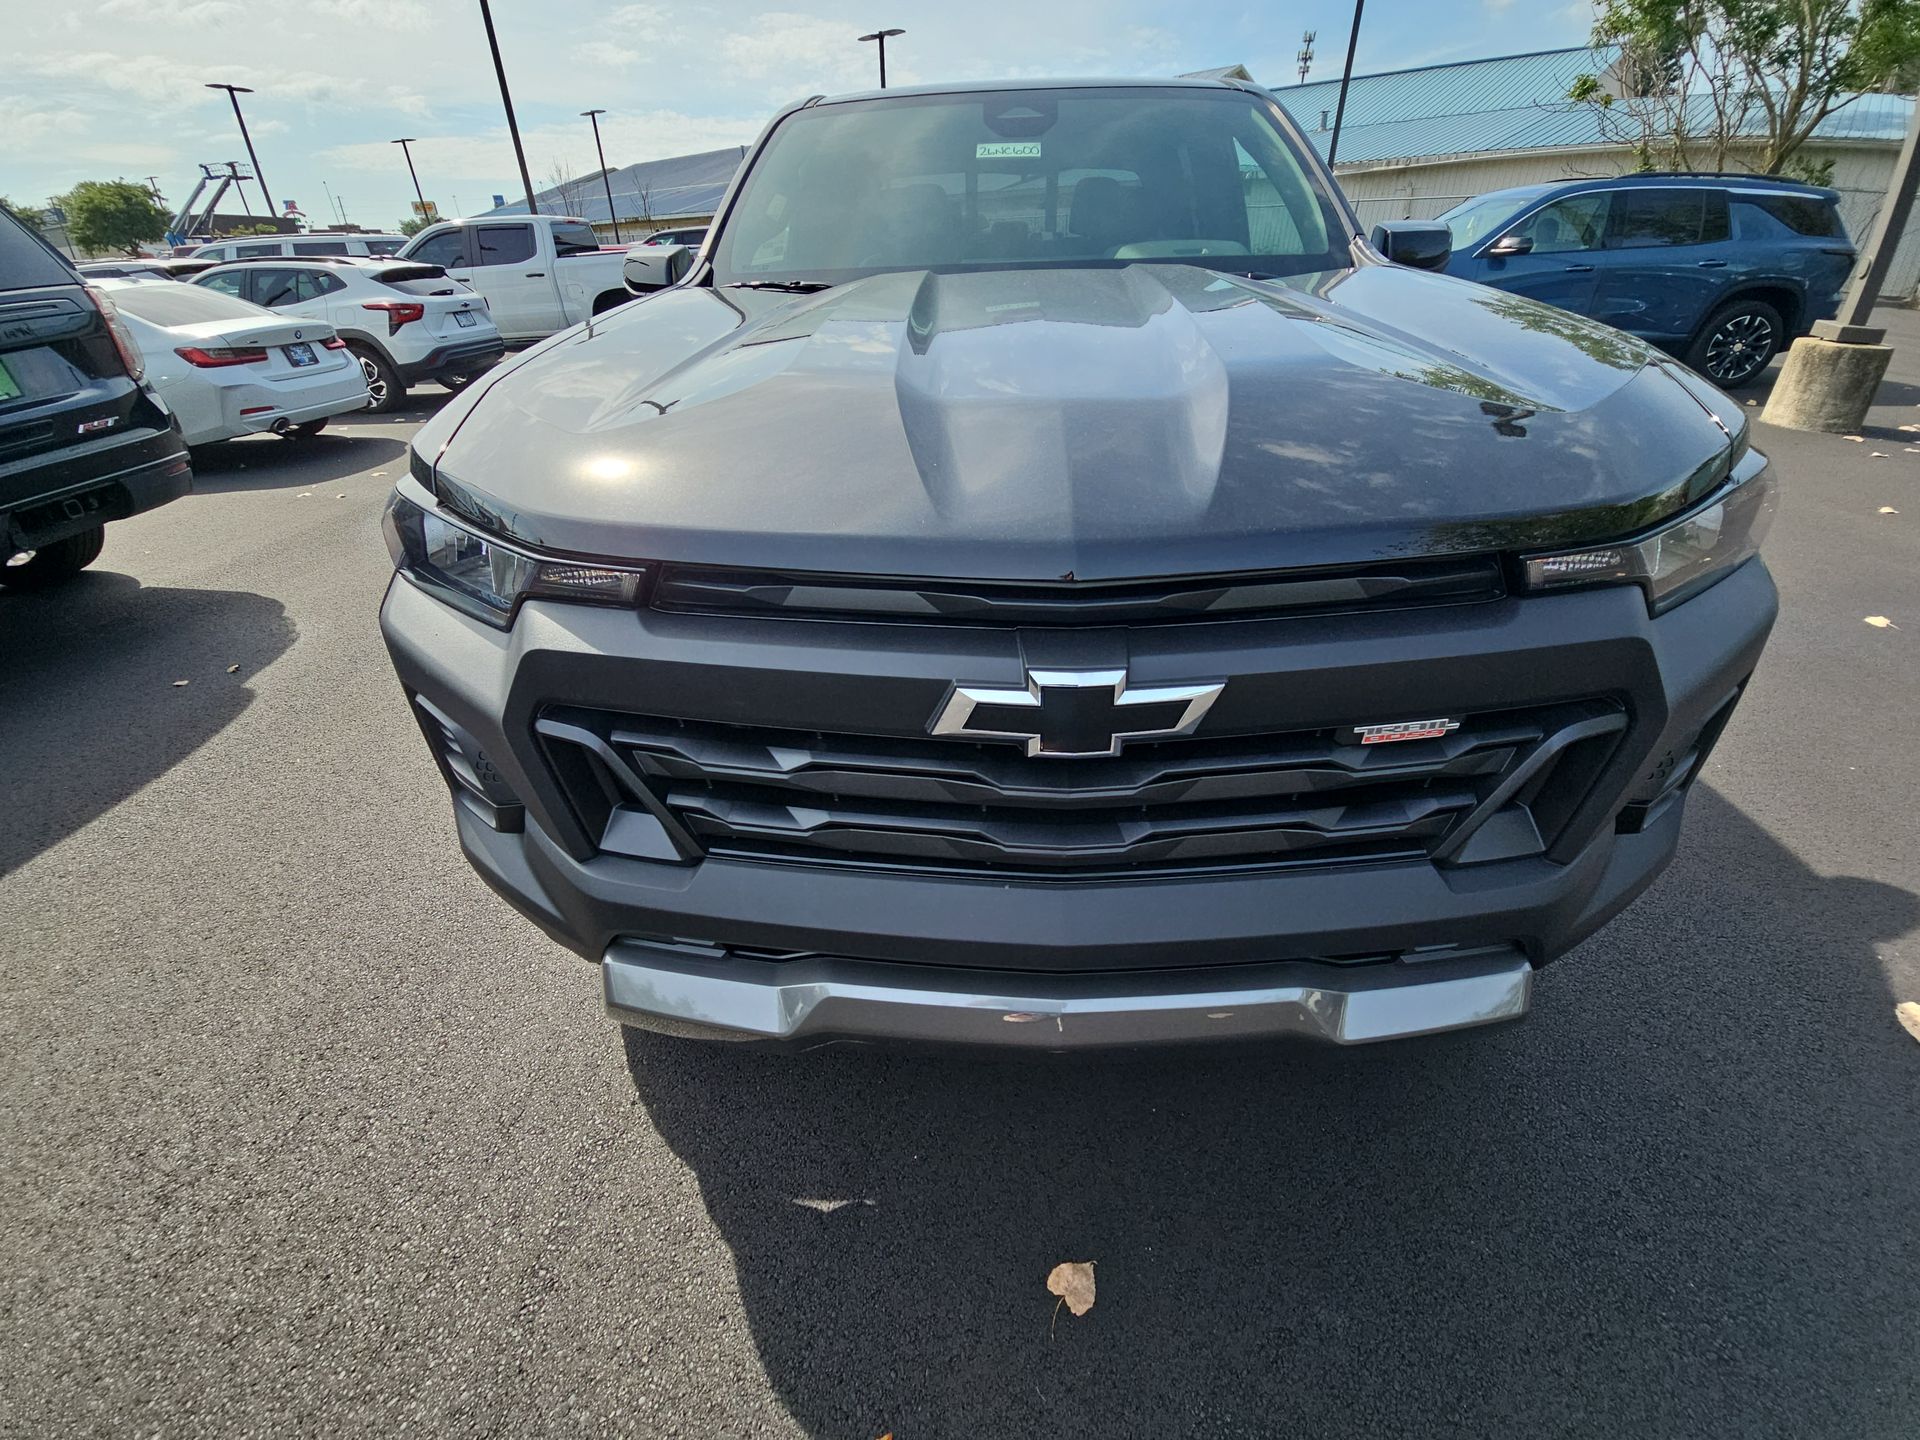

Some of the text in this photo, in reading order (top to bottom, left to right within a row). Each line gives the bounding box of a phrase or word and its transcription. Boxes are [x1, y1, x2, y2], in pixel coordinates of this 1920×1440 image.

[77, 415, 119, 434] RST
[1353, 718, 1460, 736] TRAIL
[1361, 728, 1447, 744] BOSS
